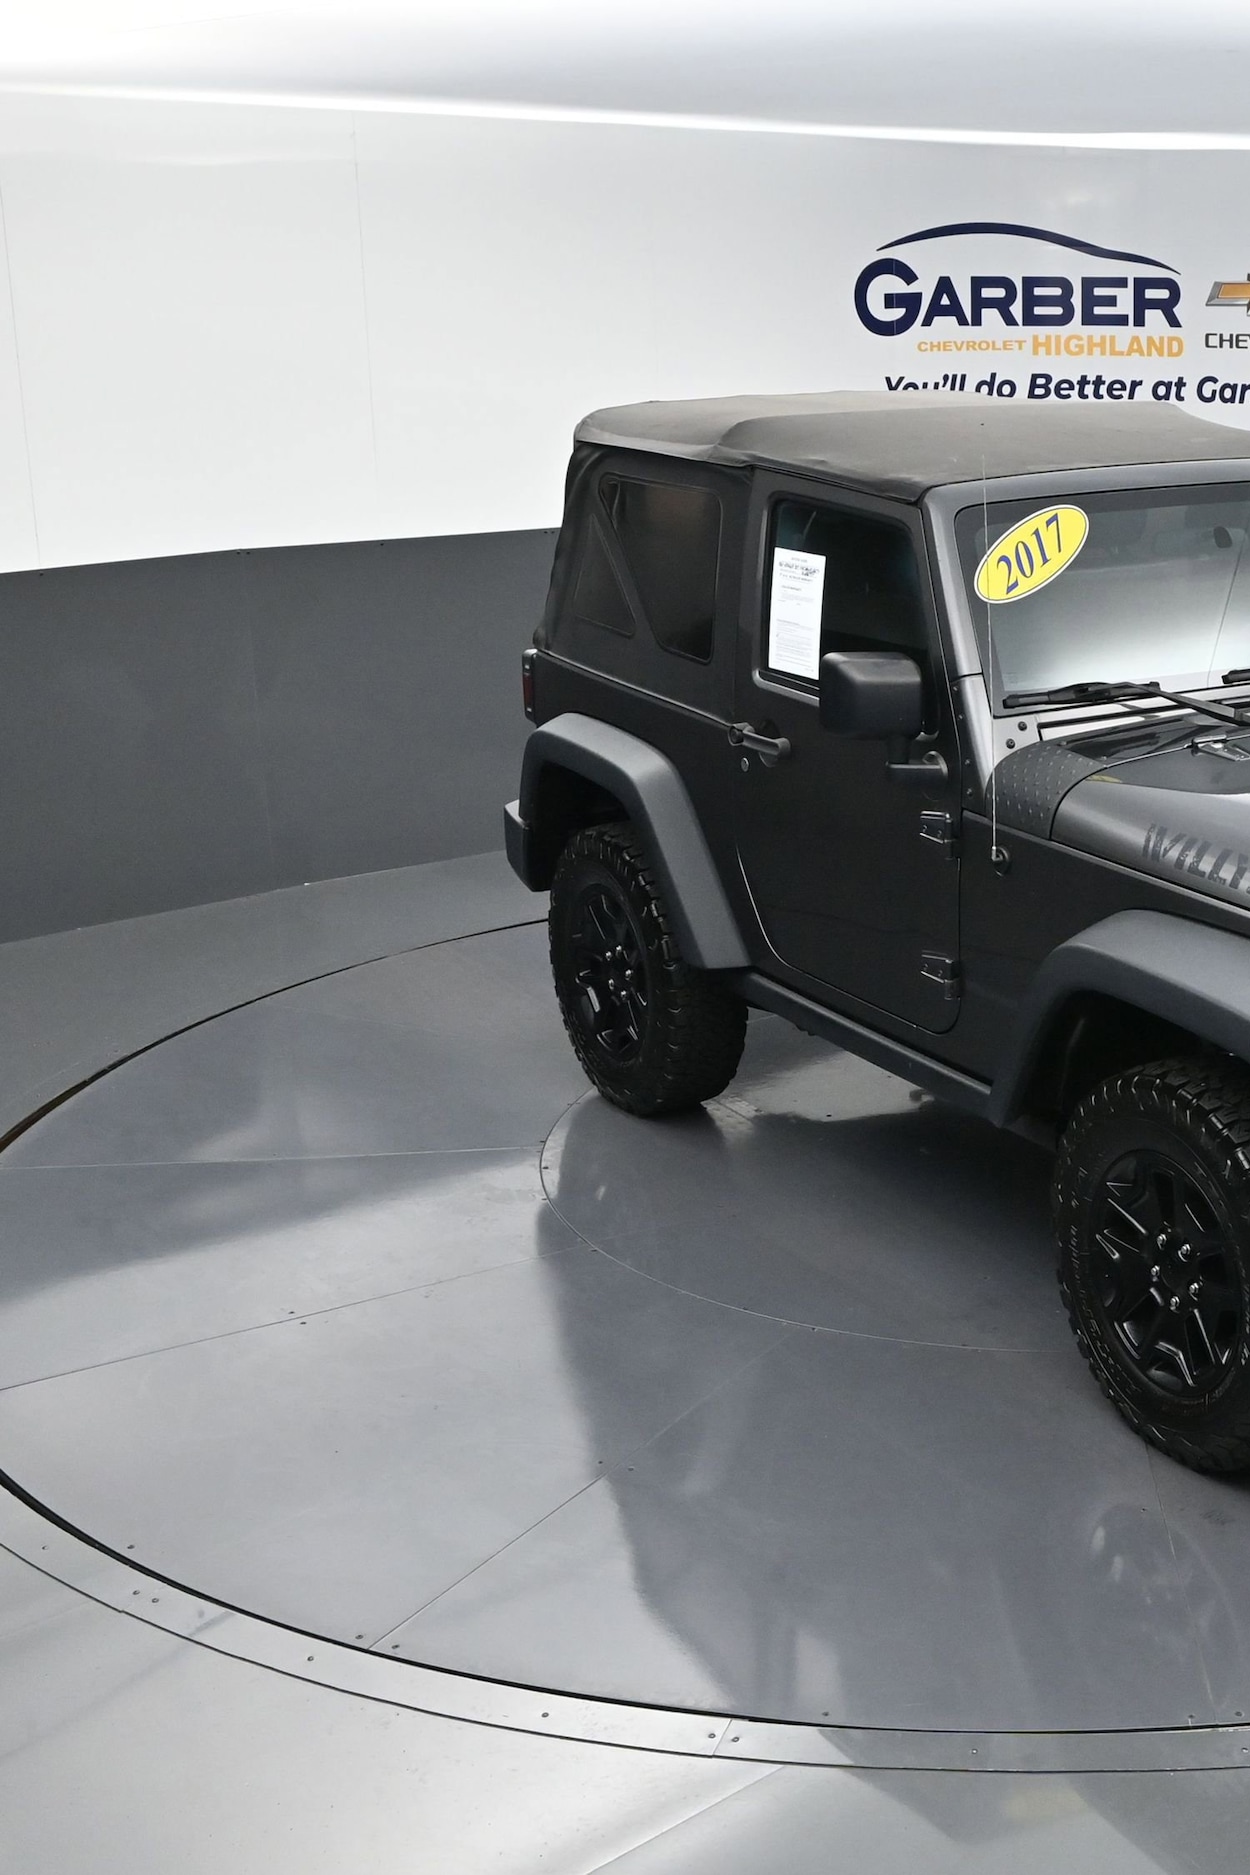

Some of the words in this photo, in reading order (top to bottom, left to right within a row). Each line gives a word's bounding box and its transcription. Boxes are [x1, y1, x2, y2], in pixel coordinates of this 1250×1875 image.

[854, 257, 1183, 337] GARBER
[917, 340, 1027, 352] CHEVROLET
[1032, 334, 1184, 358] HIGHLAND
[975, 372, 1017, 398] do
[1027, 373, 1143, 401] Better
[1151, 376, 1187, 401] at
[997, 513, 1062, 595] 2017
